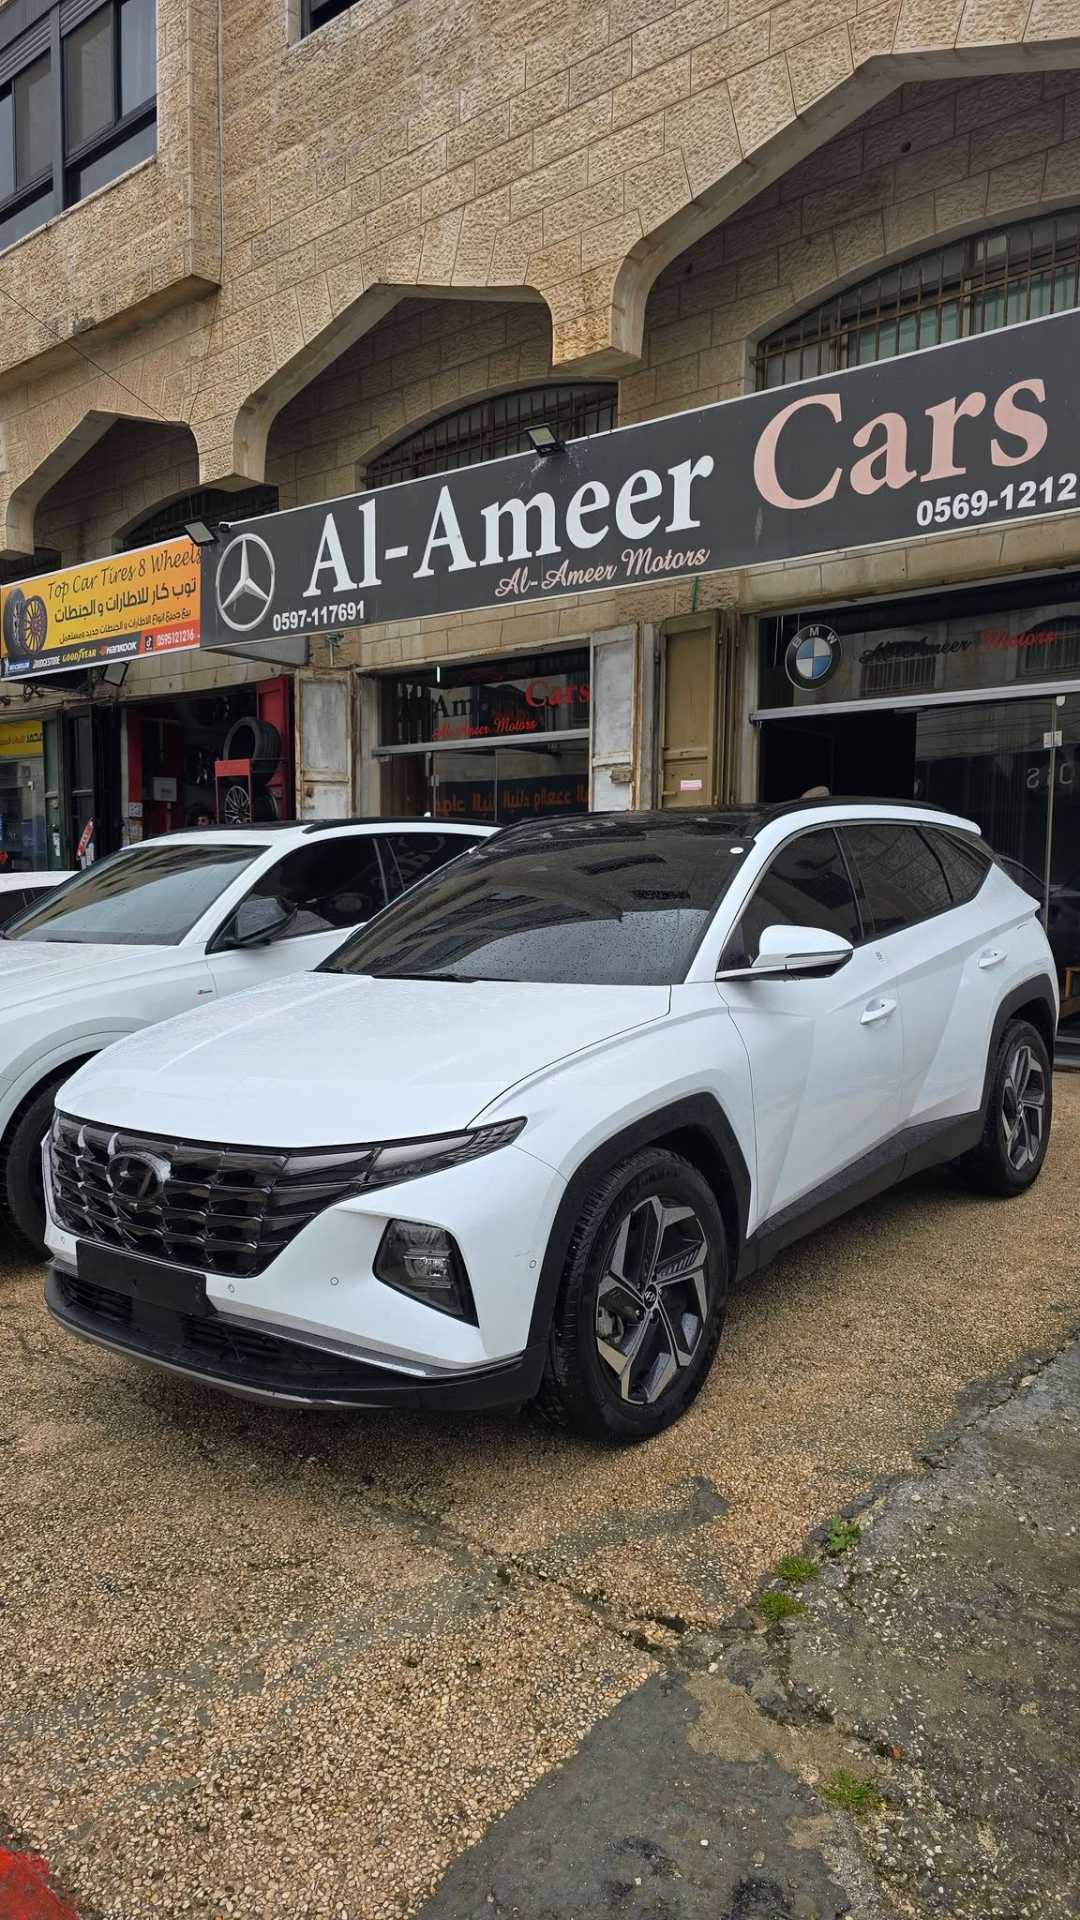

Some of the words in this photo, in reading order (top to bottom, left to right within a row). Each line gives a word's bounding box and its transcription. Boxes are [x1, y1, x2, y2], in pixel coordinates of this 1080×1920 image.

[302, 455, 715, 598] Al-Ameer
[753, 378, 1048, 509] Cars
[916, 472, 1077, 526] 0569-1212
[48, 578, 68, 604] Top
[73, 571, 97, 592] Car
[100, 560, 134, 586] Tires
[152, 582, 168, 604] كار
[172, 577, 196, 599] توب
[495, 559, 618, 597] Al-Ameer
[621, 547, 711, 577] Motors
[273, 600, 365, 631] 0597-117691
